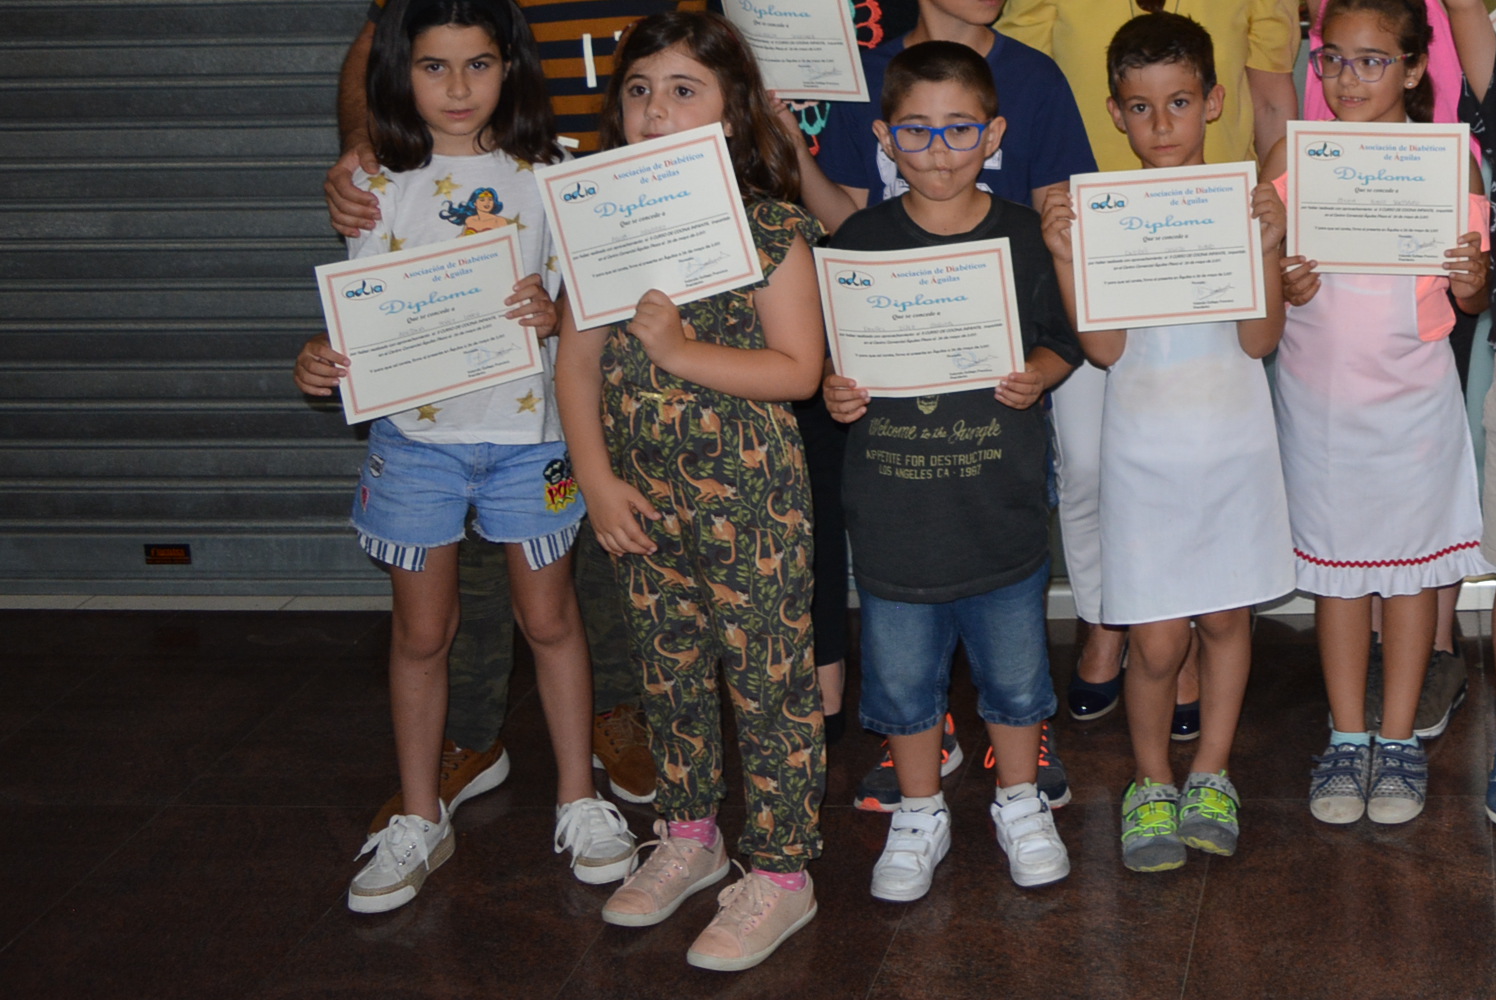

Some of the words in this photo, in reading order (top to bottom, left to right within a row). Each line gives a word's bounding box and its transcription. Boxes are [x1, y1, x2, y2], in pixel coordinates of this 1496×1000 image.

[1308, 142, 1340, 156] adia
[613, 164, 651, 181] Asociación
[655, 162, 662, 170] de
[665, 151, 703, 167] Diabéticos
[640, 176, 648, 184] de
[1334, 168, 1425, 186] Diploma
[564, 183, 596, 201] adia
[1144, 189, 1182, 198] Asociación
[1195, 185, 1233, 194] Diabéticos
[594, 191, 691, 218] Diploma
[1091, 194, 1125, 209] adia
[1120, 215, 1214, 234] Diploma
[404, 264, 443, 280] Asociación
[447, 261, 455, 270] de
[458, 251, 498, 267] Diabéticos
[891, 267, 931, 279] Asociación
[935, 266, 943, 274] de
[946, 261, 986, 273] Diabéticos
[433, 274, 441, 282] de
[839, 272, 871, 286] adia
[346, 280, 383, 298] adia
[379, 287, 481, 316] Diploma
[867, 295, 968, 312] Diploma
[868, 417, 917, 441] Welcome
[920, 427, 930, 439] to
[932, 426, 949, 438] the
[949, 417, 1002, 446] Jungle
[866, 449, 902, 466] APPETITE
[905, 455, 925, 467] FOR
[930, 448, 1002, 467] DESTRUCTION
[879, 464, 893, 475] LOS
[895, 468, 933, 480] ANGELES
[937, 468, 950, 478] CA
